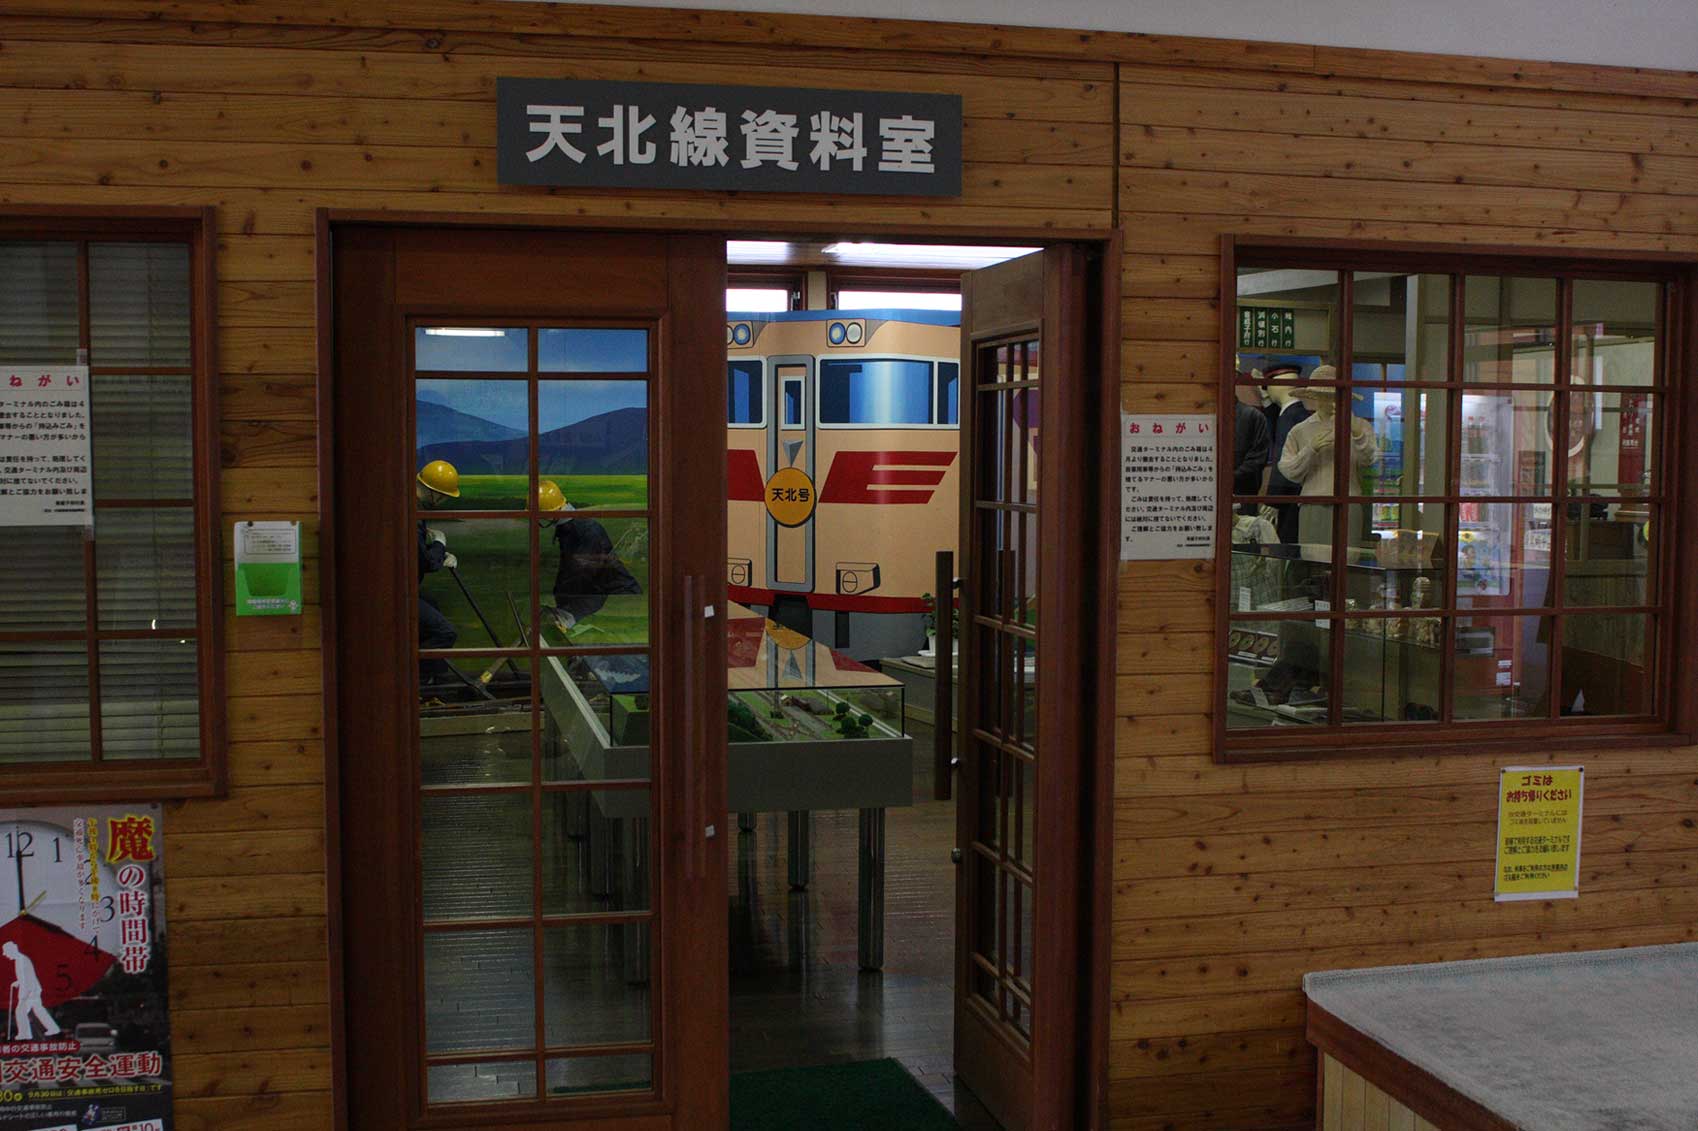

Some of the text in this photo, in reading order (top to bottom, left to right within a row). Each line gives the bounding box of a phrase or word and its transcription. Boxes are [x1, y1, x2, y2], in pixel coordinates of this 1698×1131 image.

[525, 104, 936, 173] 天北線資料室
[1129, 422, 1209, 434] おねがい
[771, 488, 811, 502] 天北号
[1521, 775, 1553, 786] ゴミは
[1506, 789, 1572, 803] お持ち帰りください
[6, 831, 34, 858] 12
[53, 837, 62, 863] 1
[107, 816, 154, 974] 魔の時間帯
[100, 896, 115, 922] 3
[85, 935, 100, 961] 4
[56, 964, 72, 993] 5
[0, 1041, 78, 1055] 者の交通事故防止
[0, 1052, 162, 1083] 交通安全運動
